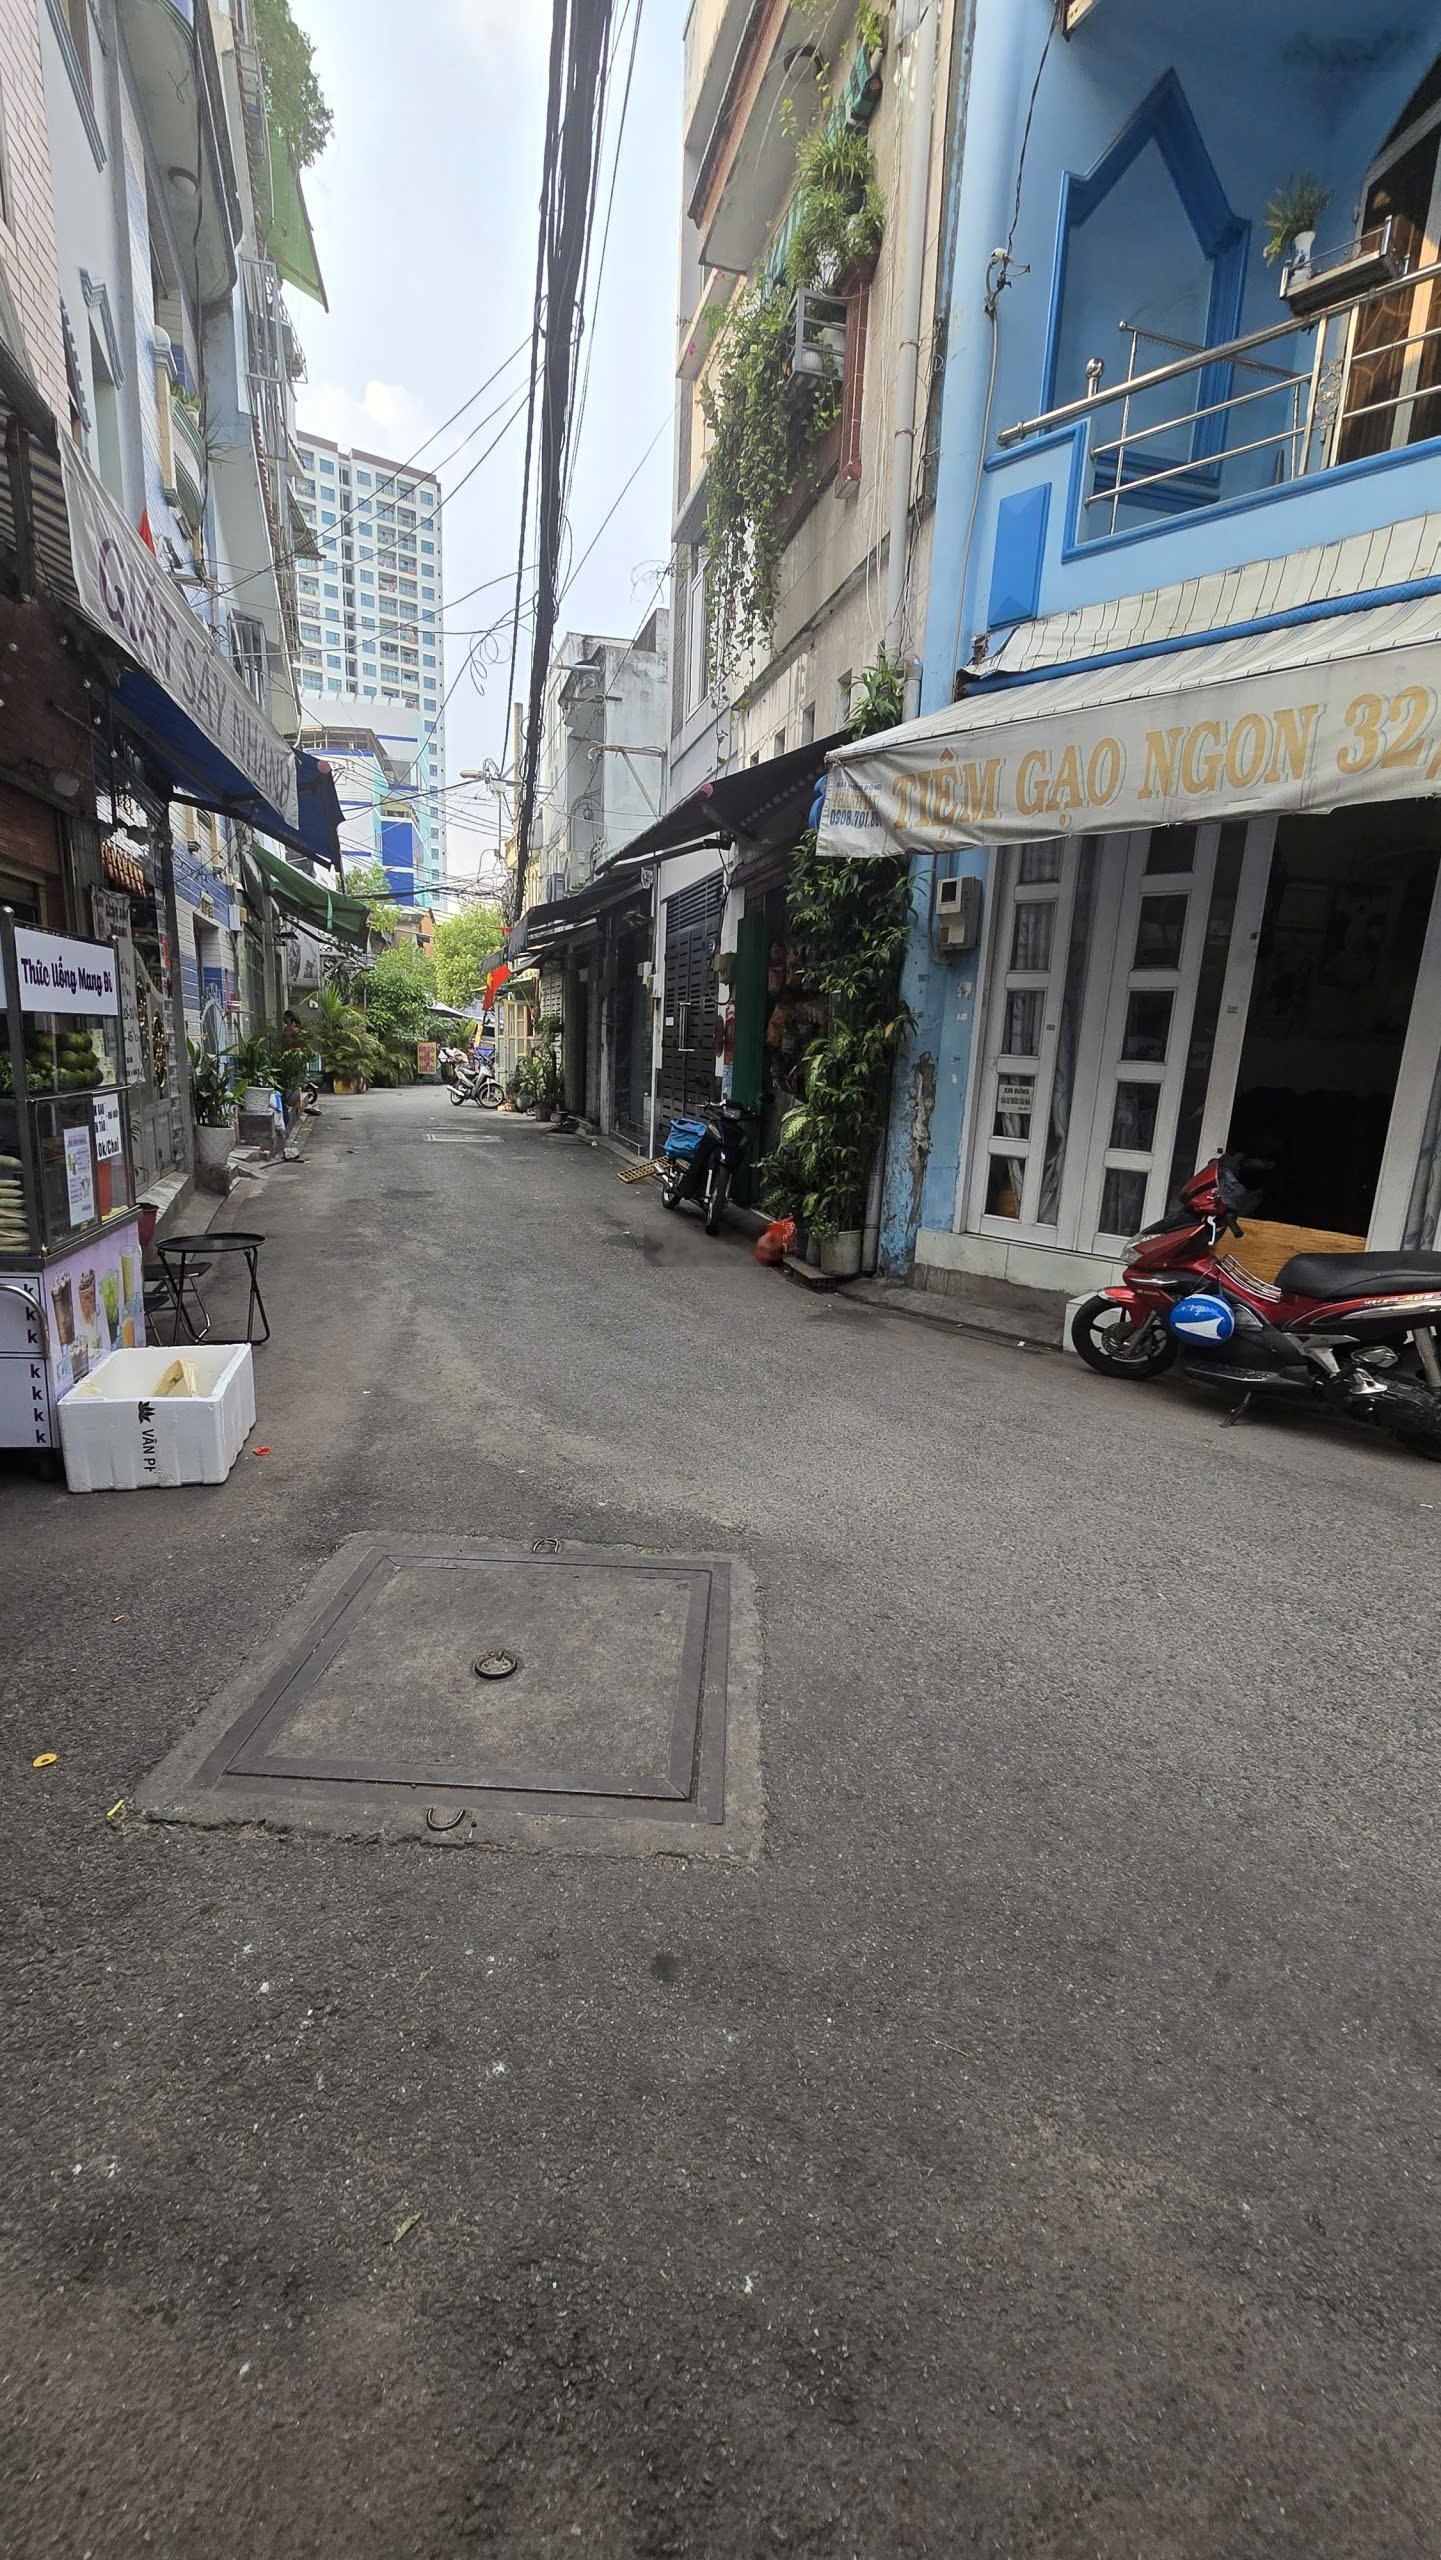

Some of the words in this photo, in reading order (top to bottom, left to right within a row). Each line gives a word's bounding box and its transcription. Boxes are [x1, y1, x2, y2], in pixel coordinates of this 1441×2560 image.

[892, 747, 1006, 841] TIỆM
[1016, 737, 1128, 830] GẠO
[1137, 703, 1326, 801] NGON
[20, 957, 50, 987] Thức
[51, 955, 78, 995] Uống
[78, 966, 103, 997] Mang
[103, 970, 113, 993] Đi
[25, 1306, 37, 1321] k
[27, 1329, 39, 1343] k
[30, 1364, 42, 1379] k
[32, 1386, 43, 1400] k
[34, 1408, 45, 1422] k
[35, 1429, 47, 1443] k
[142, 1428, 158, 1454] VÂN
